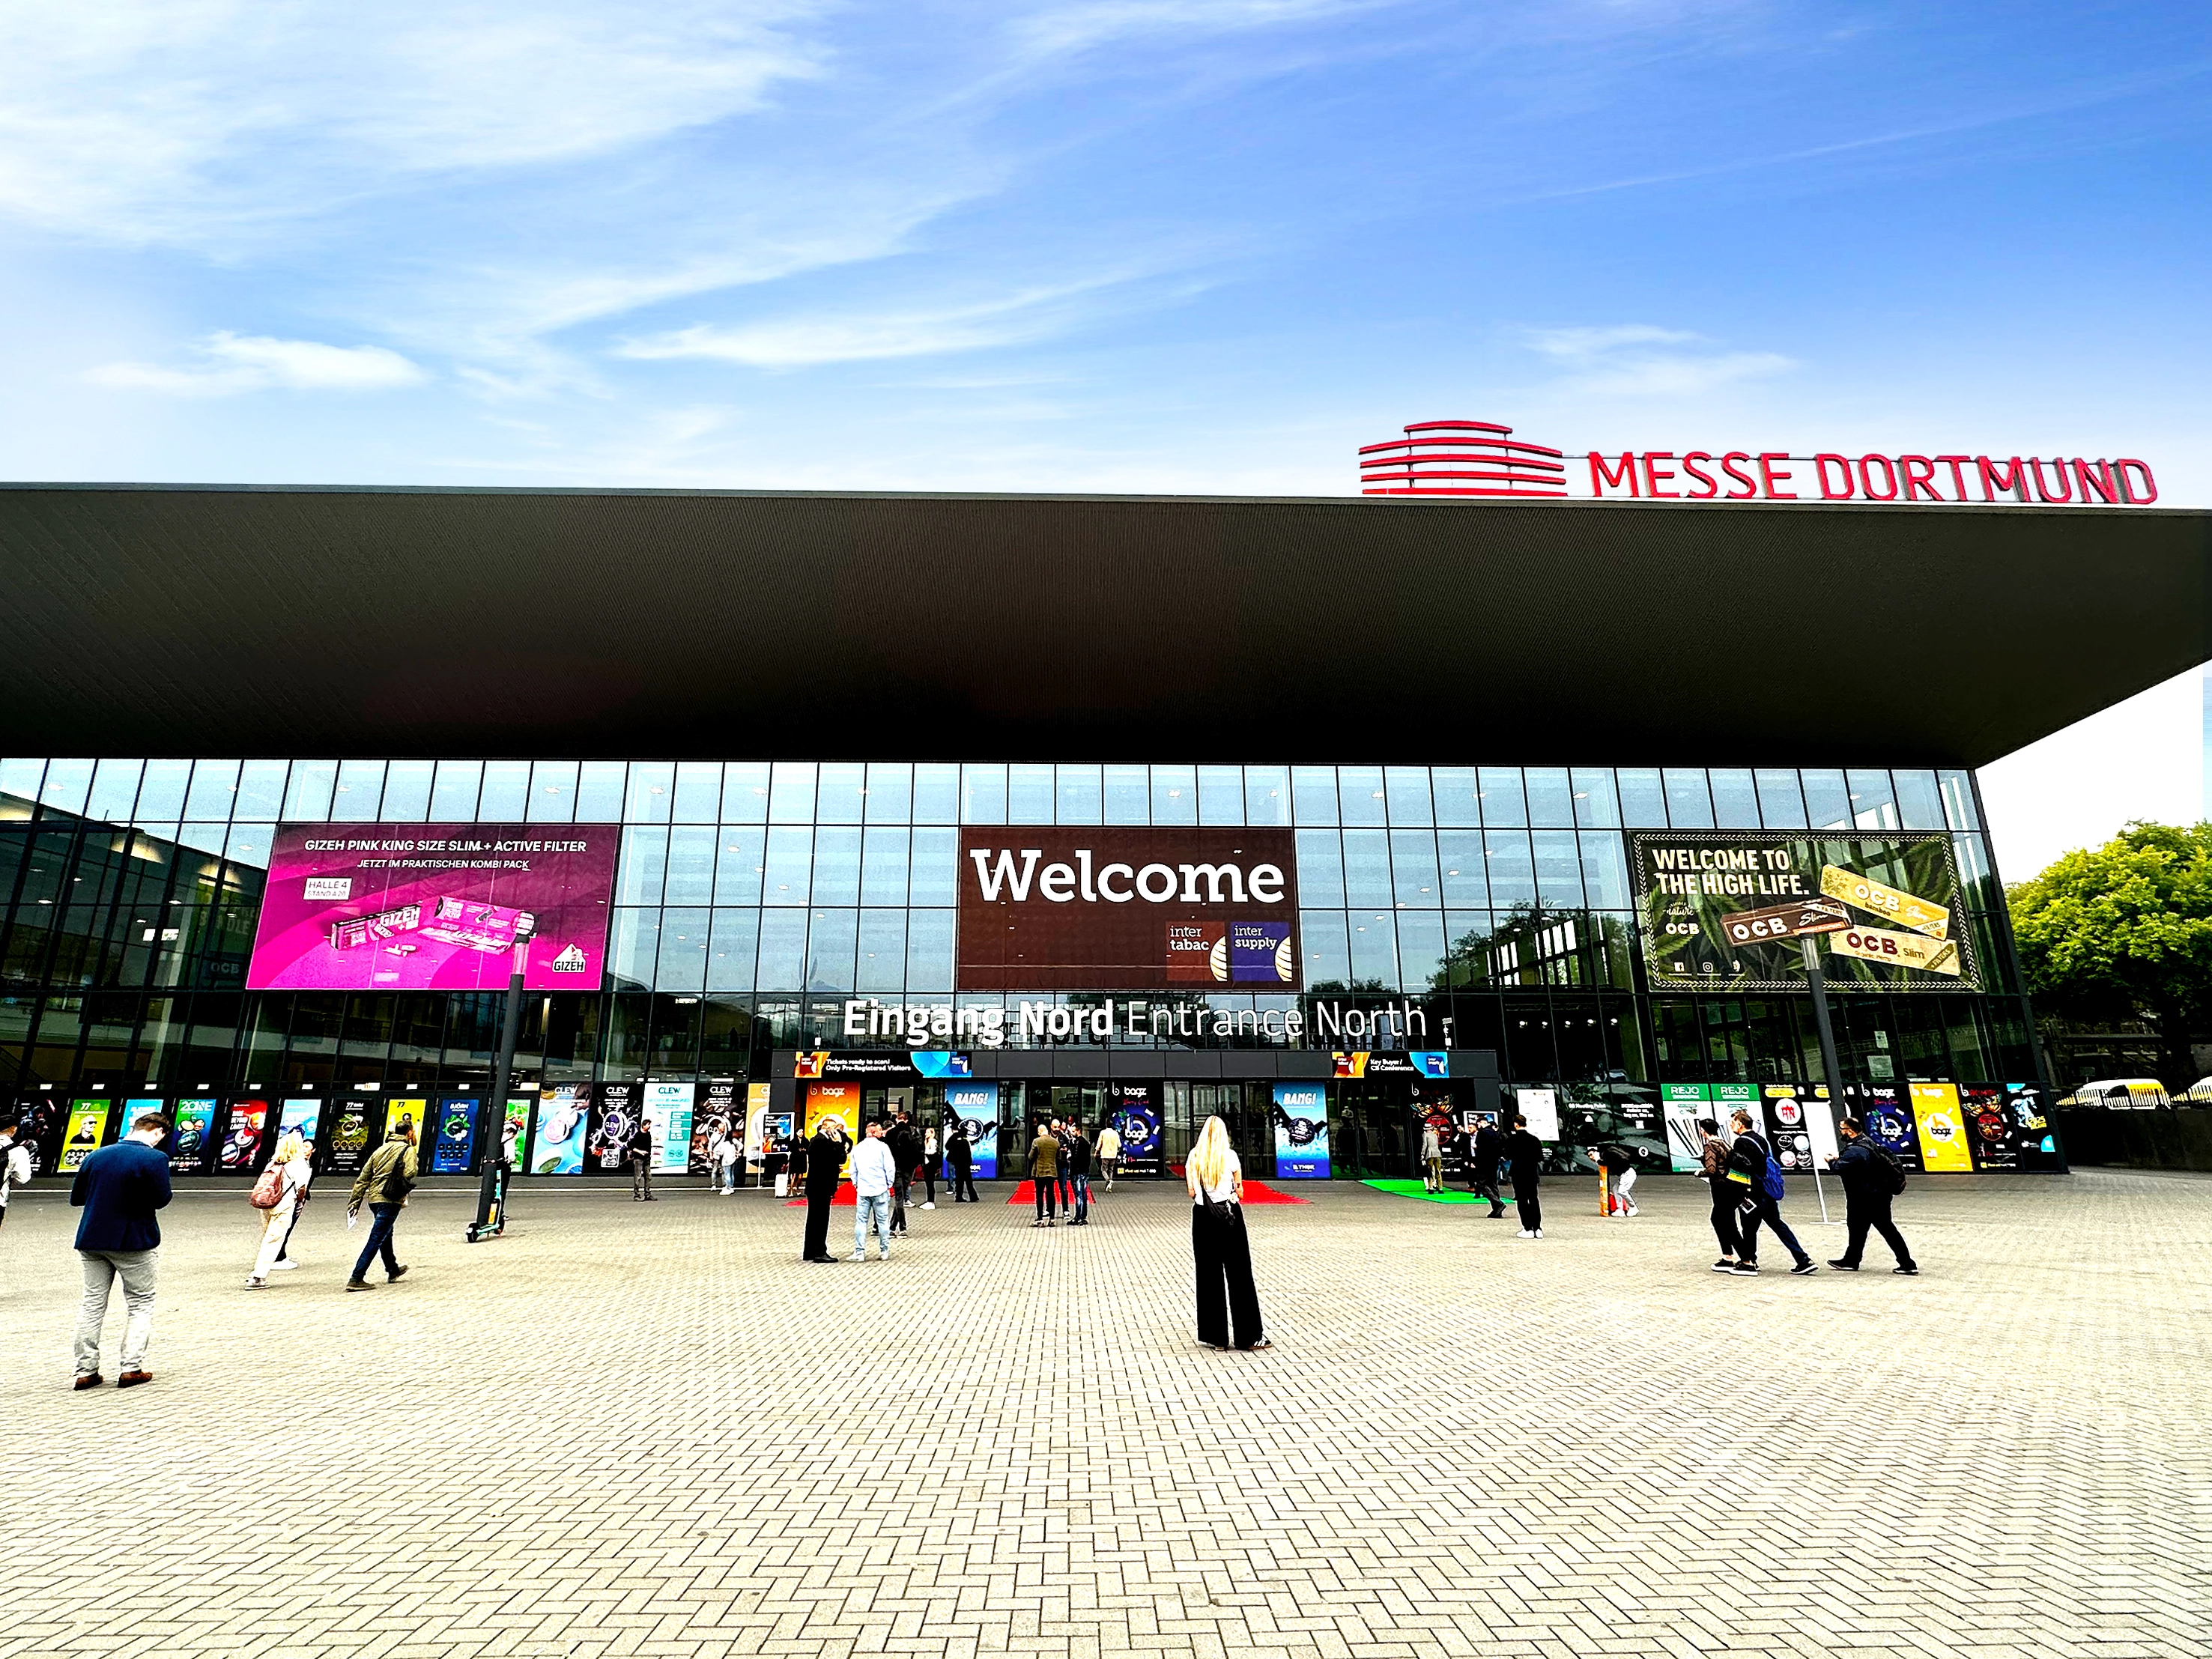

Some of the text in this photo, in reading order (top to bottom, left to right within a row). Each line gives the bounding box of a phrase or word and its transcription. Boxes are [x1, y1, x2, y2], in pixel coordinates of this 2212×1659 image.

[1587, 451, 2158, 505] MESSE DORTMUND
[304, 839, 345, 851] GIZEH
[347, 840, 380, 851] PINK
[381, 840, 414, 851] KING
[416, 840, 446, 851] SIZE
[448, 840, 482, 852] SLIM
[493, 840, 542, 852] ACTIVE
[543, 840, 587, 852] FILTER
[357, 860, 529, 869] JETZT IM PRAKTISCHEN KOMBI PACK
[1652, 849, 1790, 870] WELCOME TO
[969, 849, 1285, 904] Welcome
[309, 881, 339, 889] HALLE
[1654, 873, 1810, 895] THE HIGH LIFE.
[1854, 884, 1902, 913] OCB
[1864, 902, 1891, 917] bamboo
[380, 907, 421, 927] GIZEH
[1799, 912, 1828, 927] Slim
[1170, 926, 1202, 938] inter
[1234, 926, 1263, 936] inter
[1665, 923, 1700, 935] OCB
[1733, 918, 1788, 940] OCB
[1170, 939, 1210, 951] tabac
[1234, 938, 1278, 951] supply
[1846, 932, 1898, 955] OCB
[1903, 947, 1925, 959] Slim
[554, 961, 584, 971] GIZEH
[843, 998, 1427, 1046] Eingang Nord Entrance North
[822, 1087, 845, 1097] bagz
[1124, 1087, 1147, 1098] bagz
[1670, 1086, 1700, 1094] REJO
[1720, 1086, 1749, 1094] REJO
[1873, 1088, 1895, 1098] bagz
[954, 1093, 989, 1105] BANG!
[1282, 1093, 1317, 1105] BANG!
[1125, 1129, 1148, 1141] bagz
[1880, 1126, 1903, 1137] bagz
[1931, 1127, 1951, 1137] bagz
